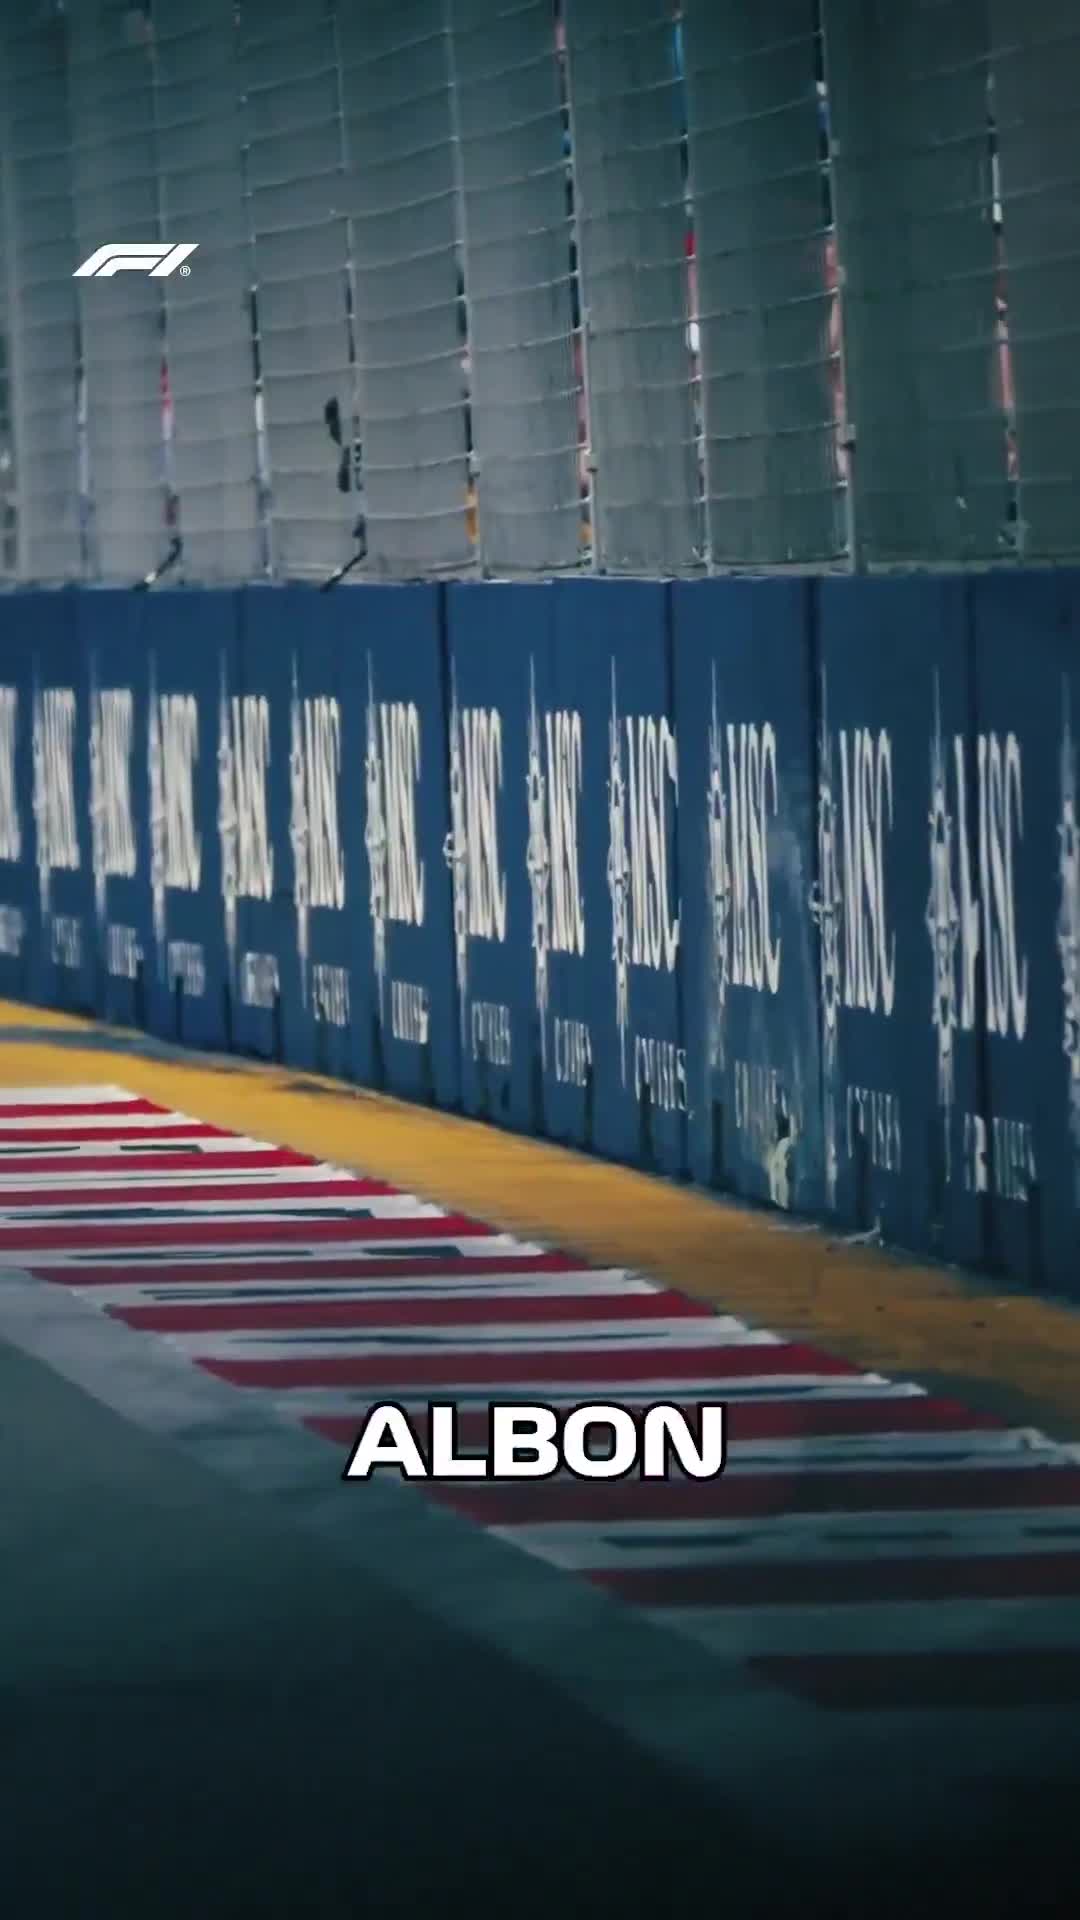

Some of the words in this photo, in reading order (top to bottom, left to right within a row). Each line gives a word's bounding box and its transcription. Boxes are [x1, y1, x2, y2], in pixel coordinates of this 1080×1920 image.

[380, 702, 424, 927] MSC
[462, 708, 507, 944] MSC
[545, 710, 585, 958] MSC
[626, 715, 682, 972] MSC
[727, 722, 781, 994] MSC
[839, 727, 896, 1017] MSC
